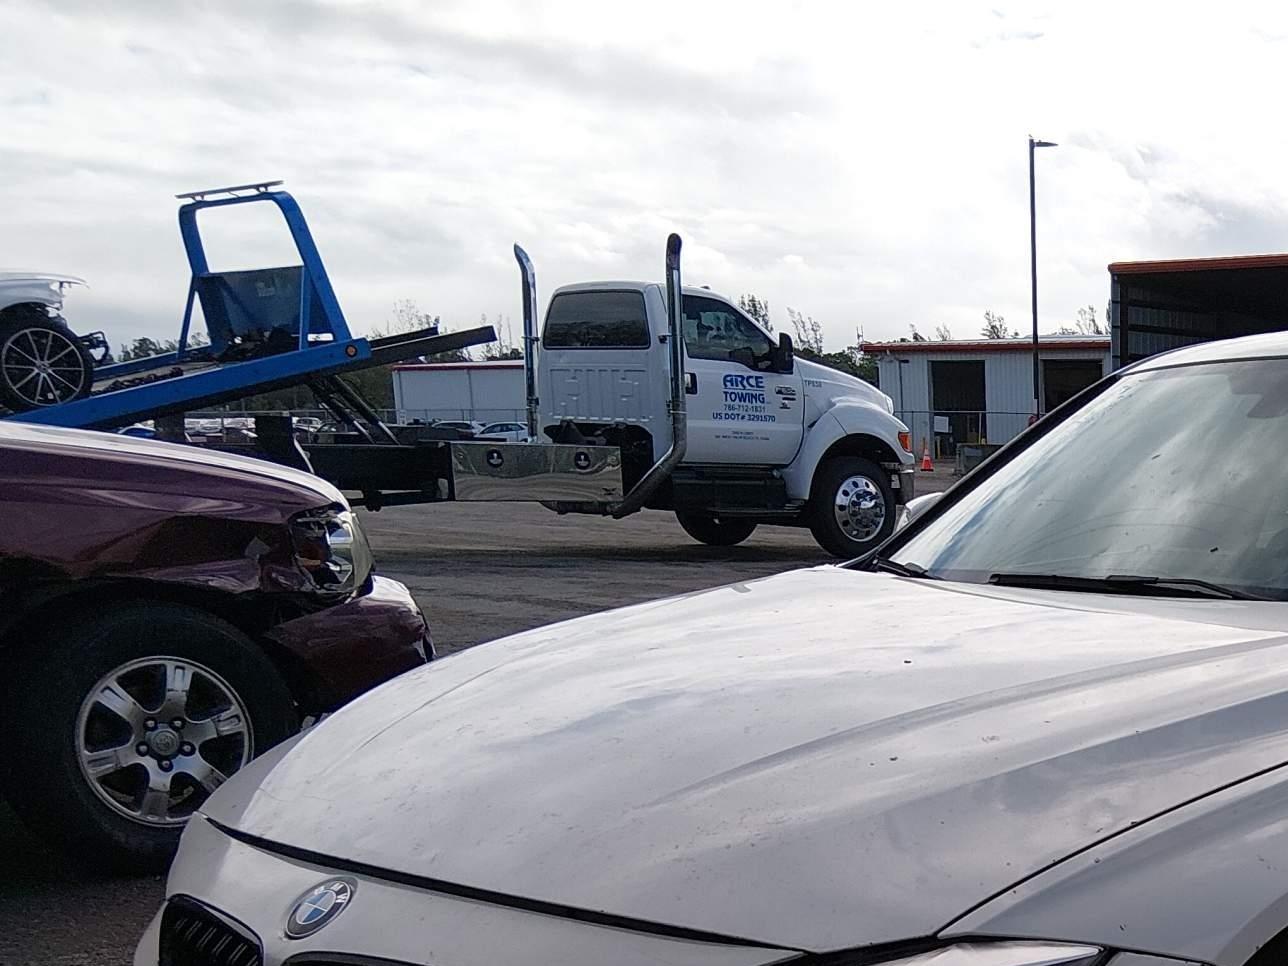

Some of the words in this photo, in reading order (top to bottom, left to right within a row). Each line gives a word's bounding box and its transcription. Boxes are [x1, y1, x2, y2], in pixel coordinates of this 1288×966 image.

[723, 374, 765, 389] ARCE
[724, 391, 765, 404] TOWING
[712, 412, 722, 420] US
